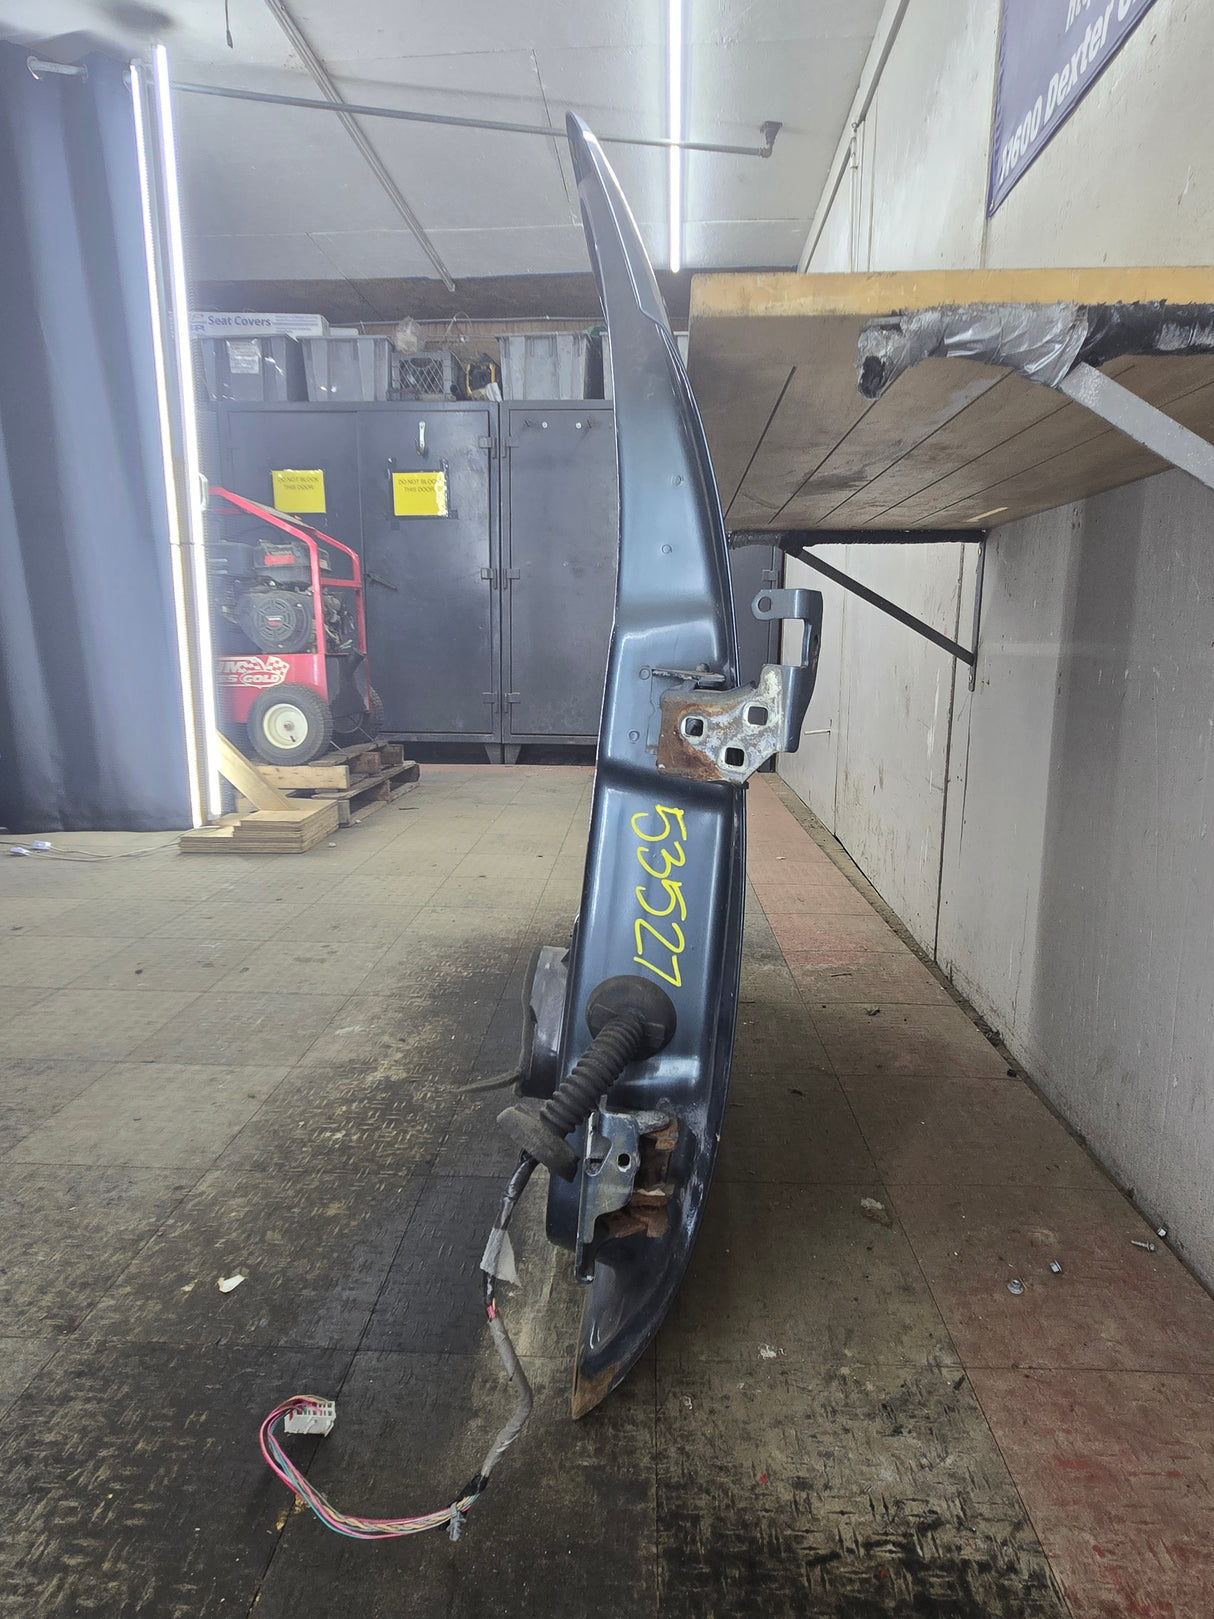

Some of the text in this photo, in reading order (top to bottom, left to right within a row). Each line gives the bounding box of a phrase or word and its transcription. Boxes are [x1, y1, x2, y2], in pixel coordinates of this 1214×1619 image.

[1043, 0, 1114, 126] Dexter
[208, 315, 232, 326] Seat
[234, 315, 272, 327] Covers
[243, 674, 279, 683] GOLD
[631, 804, 688, 987] 53527
